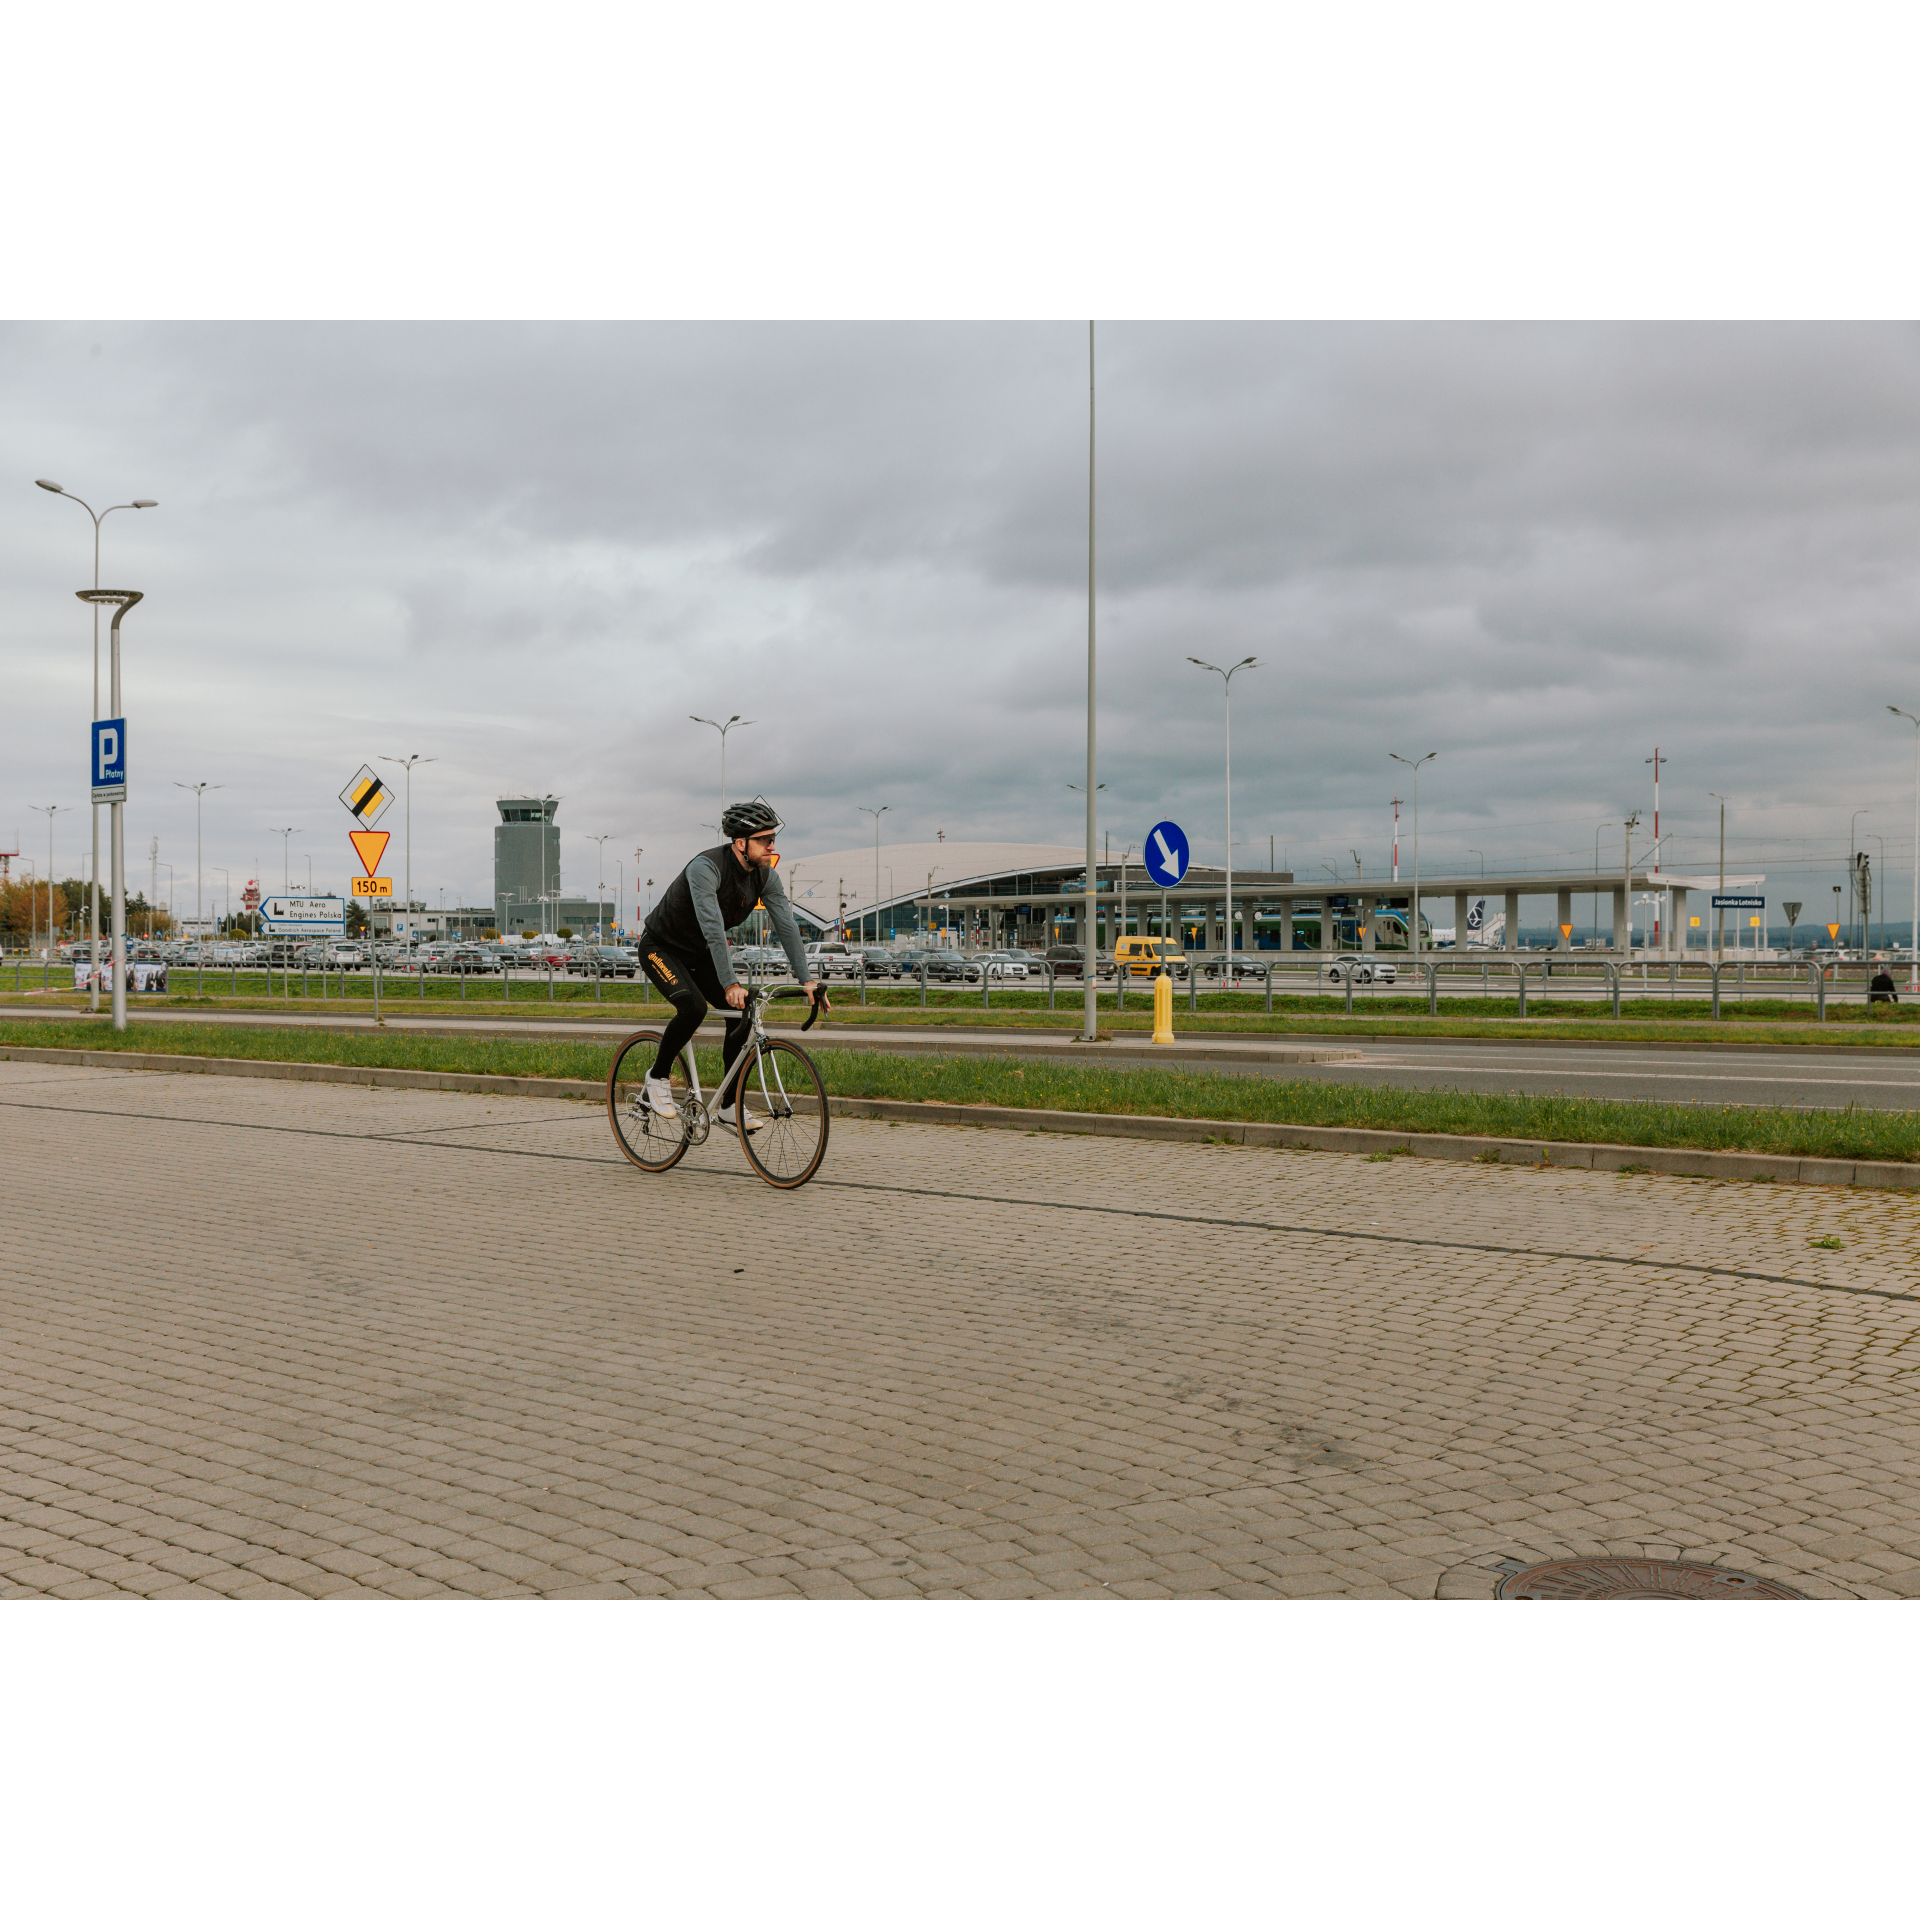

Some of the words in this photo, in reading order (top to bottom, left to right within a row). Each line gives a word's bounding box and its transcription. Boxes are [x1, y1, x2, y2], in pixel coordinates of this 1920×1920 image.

[99, 728, 118, 779] P
[106, 770, 124, 780] Płatny
[357, 880, 377, 892] 150
[290, 911, 316, 919] Engines
